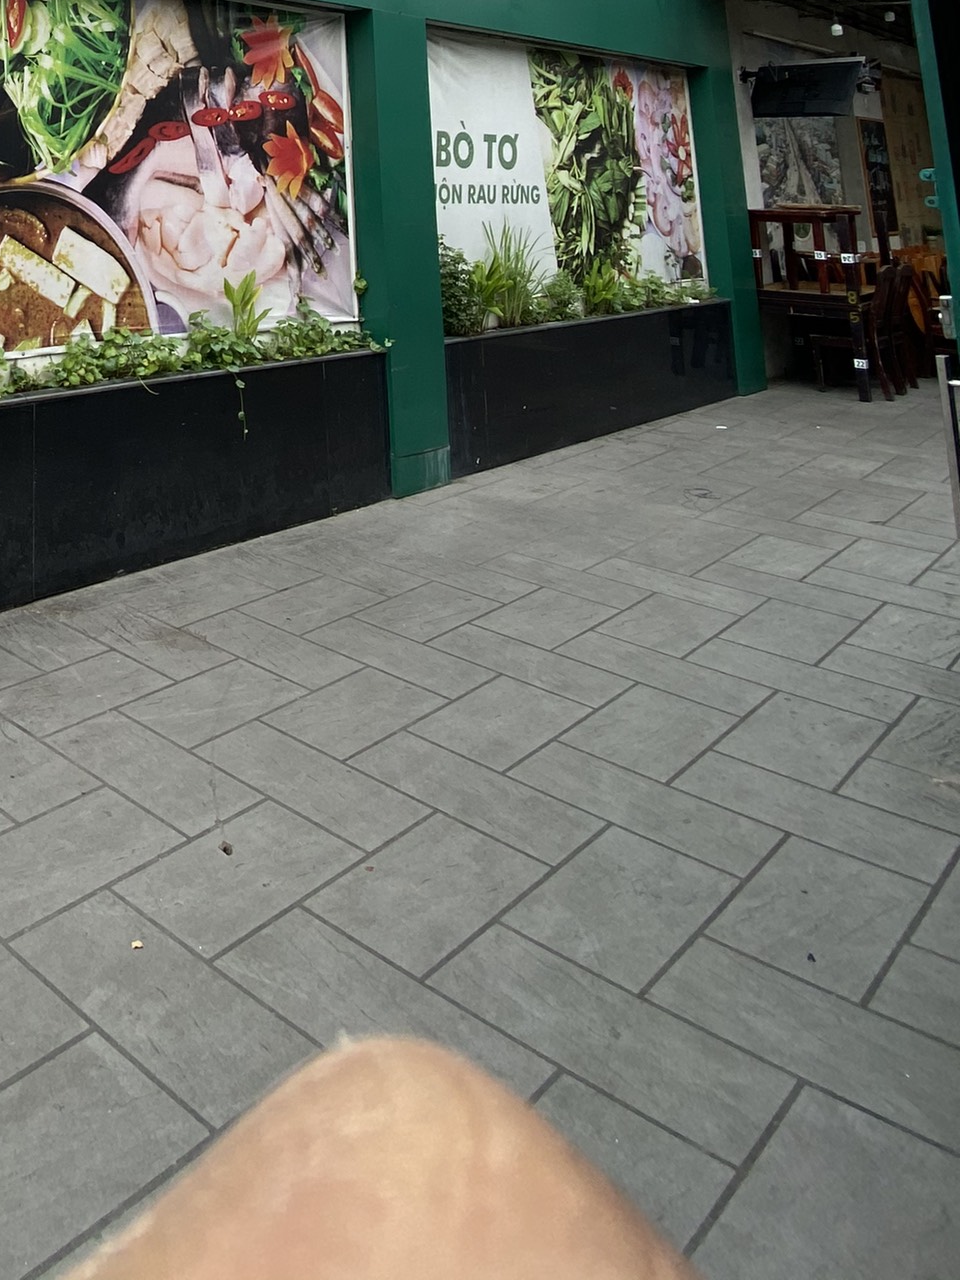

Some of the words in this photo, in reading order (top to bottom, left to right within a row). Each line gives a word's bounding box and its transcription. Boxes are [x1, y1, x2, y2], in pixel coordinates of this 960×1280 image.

[436, 120, 474, 169] BÒ
[483, 133, 519, 170] TƠ
[467, 184, 497, 204] RAU
[501, 178, 541, 205] RỪNG
